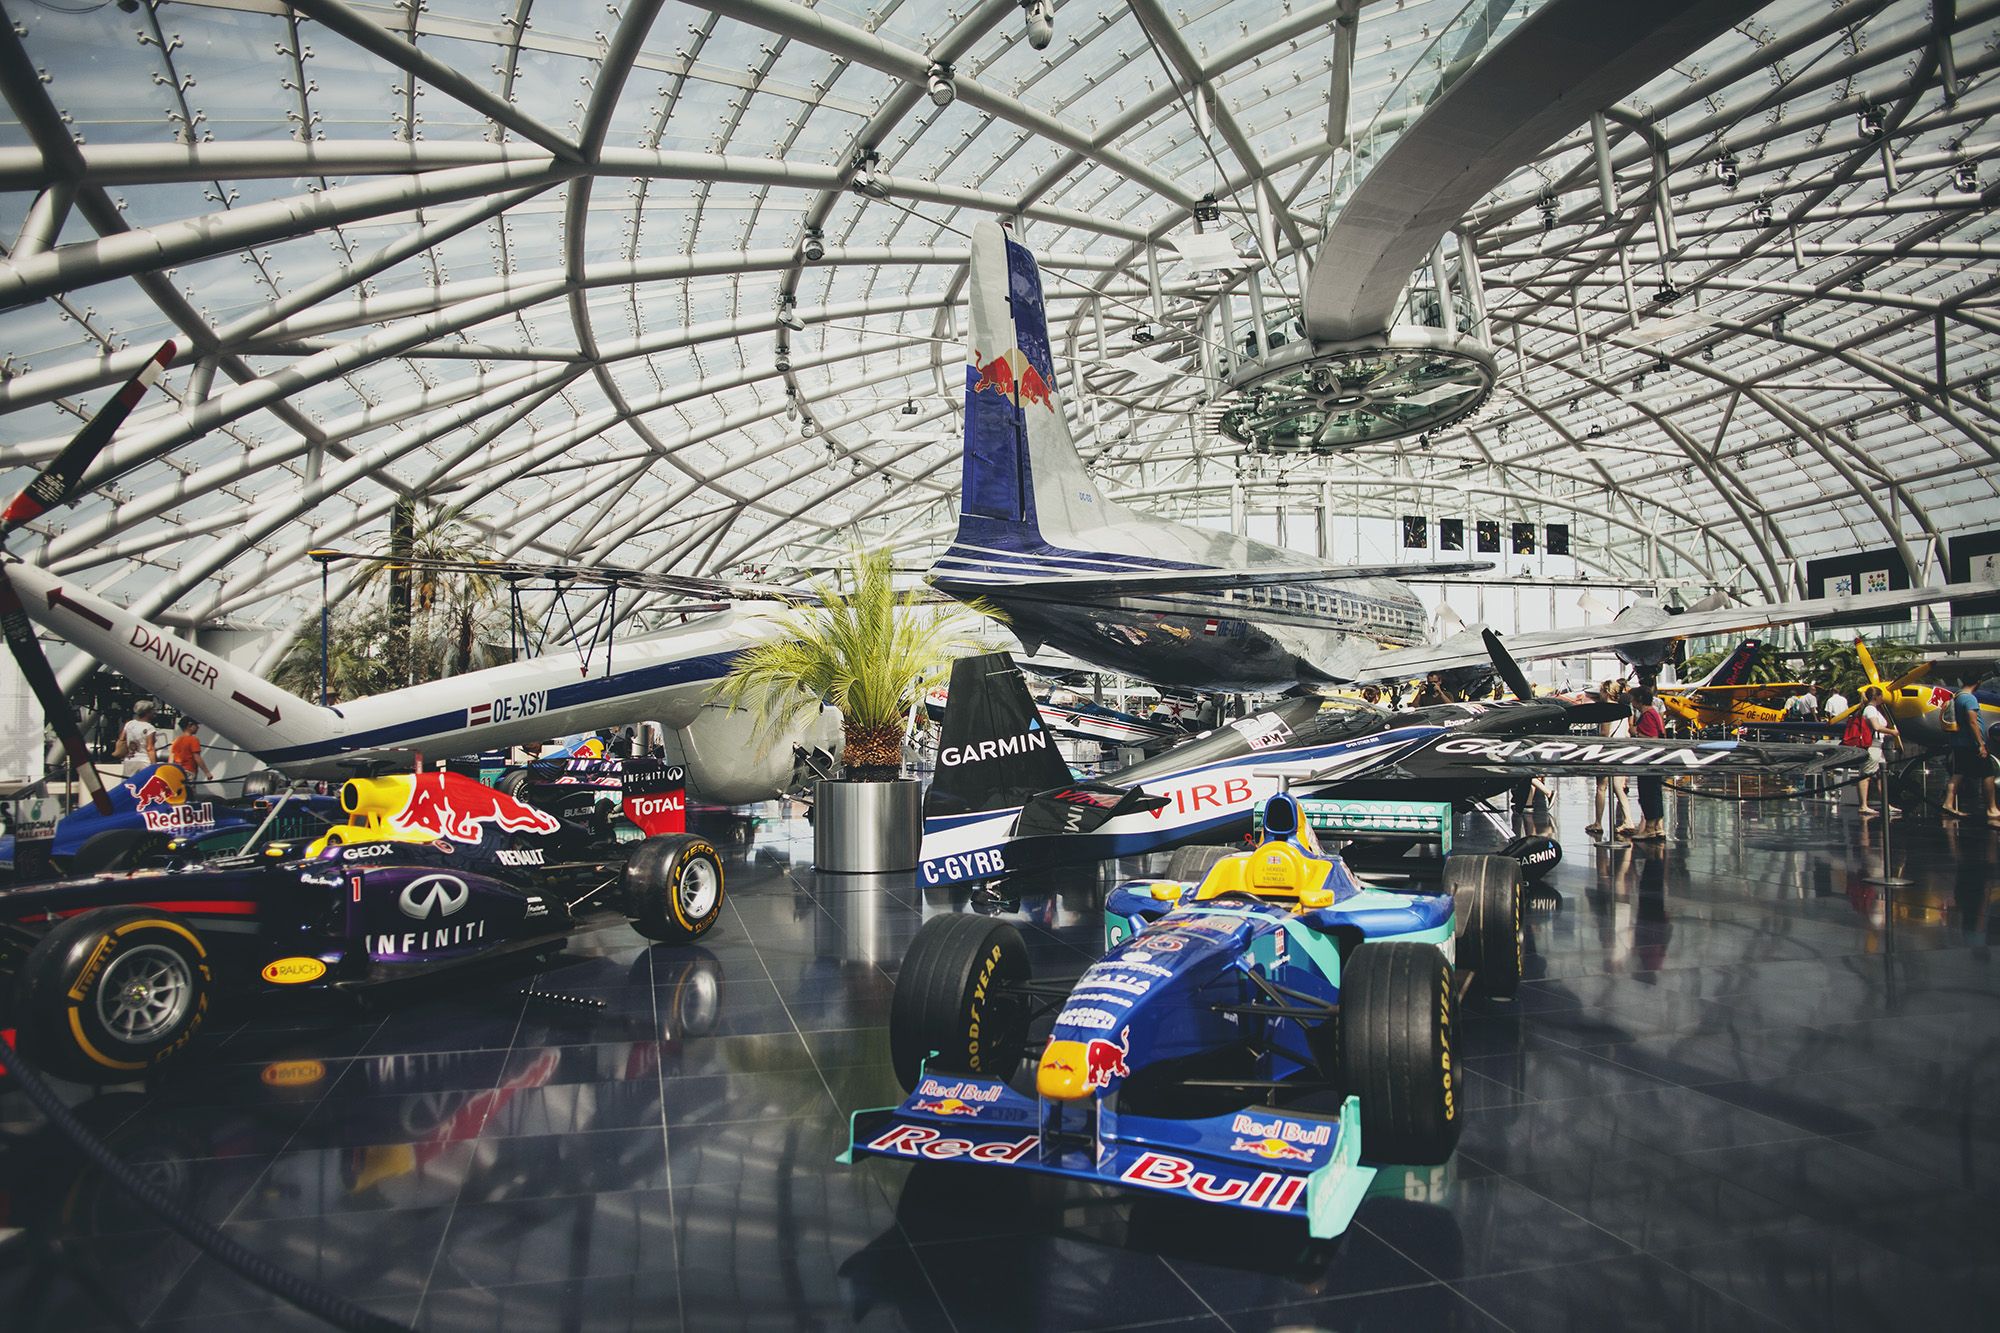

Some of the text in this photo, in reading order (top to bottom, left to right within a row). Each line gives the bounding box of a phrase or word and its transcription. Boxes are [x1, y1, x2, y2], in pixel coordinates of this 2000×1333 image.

[129, 625, 219, 690] DANGER
[493, 690, 545, 723] OE-XSY
[940, 731, 1047, 767] GARMIN
[1435, 738, 1731, 768] GARMIN
[623, 770, 665, 783] INFINITI
[147, 803, 213, 828] Red Bull
[632, 797, 684, 816] TOTAL
[343, 843, 394, 860] GEOX
[499, 848, 544, 867] RENAULT
[922, 849, 1005, 886] C-GYRB
[351, 877, 361, 902] 1
[365, 920, 485, 955] INFINITI
[1128, 935, 1190, 952] 15
[276, 963, 309, 974] RAUCH
[919, 1080, 1003, 1102] Red Bull
[1232, 1114, 1331, 1146] Red Bull
[867, 1124, 1040, 1164] Red
[1120, 1151, 1308, 1212] Bull
